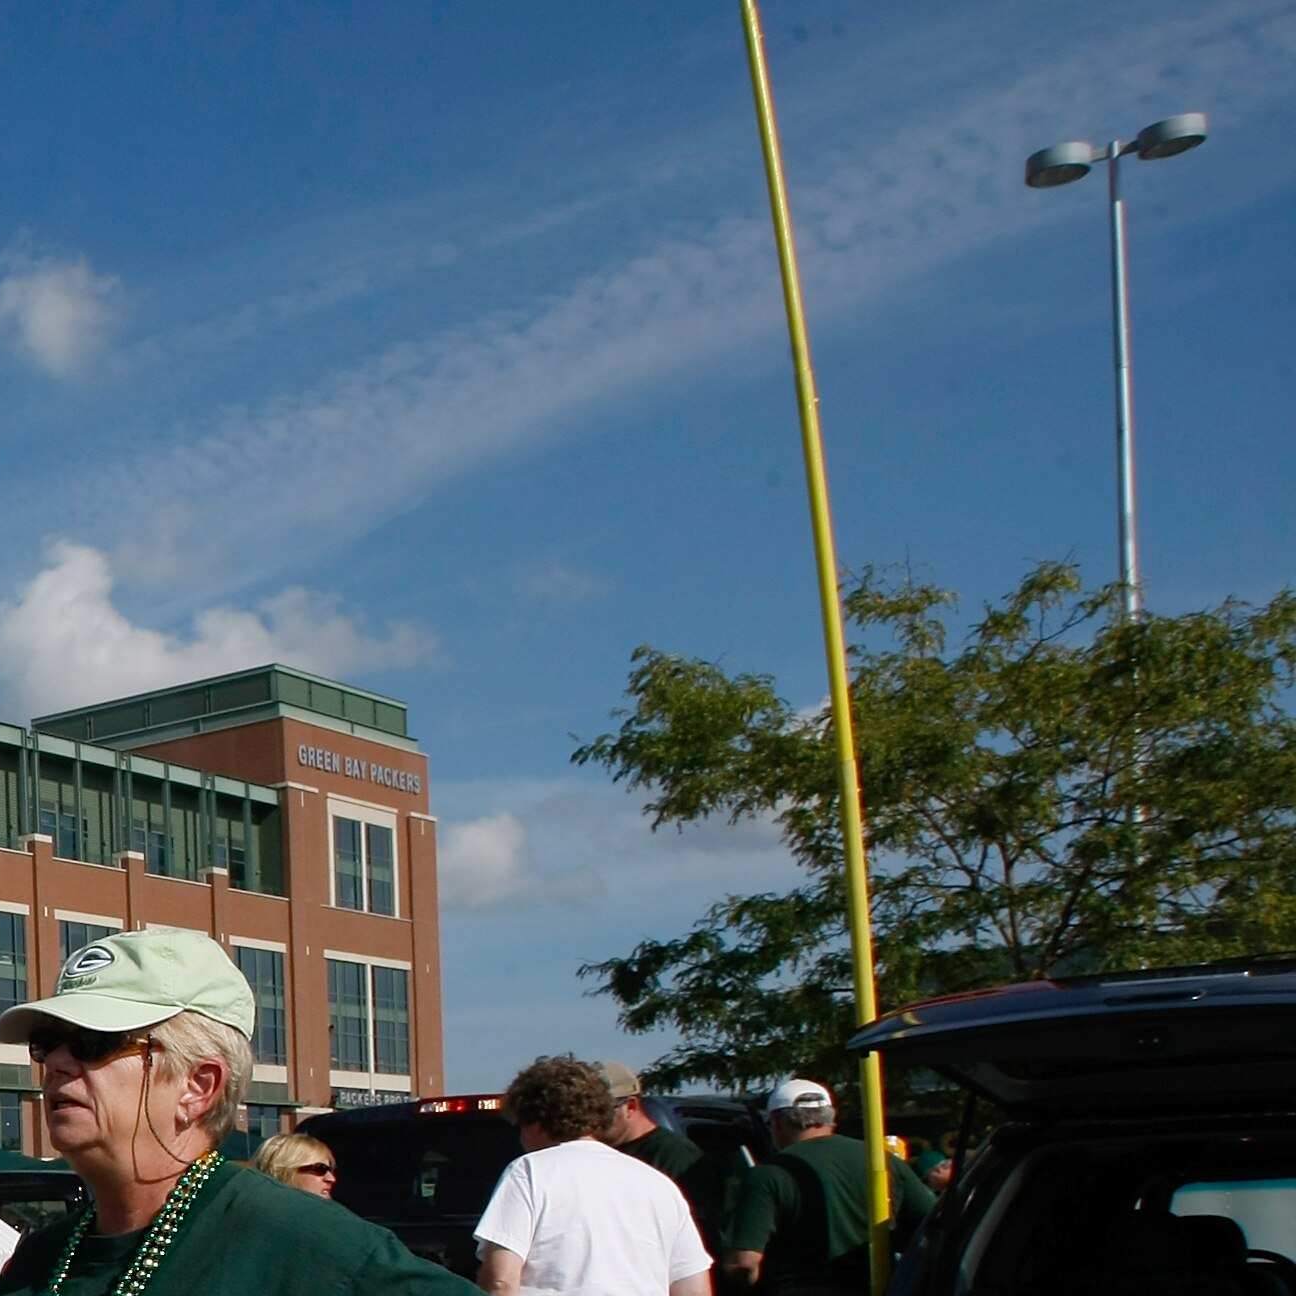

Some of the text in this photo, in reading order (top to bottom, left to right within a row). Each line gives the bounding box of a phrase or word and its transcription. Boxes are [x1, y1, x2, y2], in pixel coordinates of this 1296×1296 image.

[298, 744, 421, 795] GREEN BAY PACKERS
[68, 946, 114, 977] G
[340, 1091, 383, 1106] PACKERS
